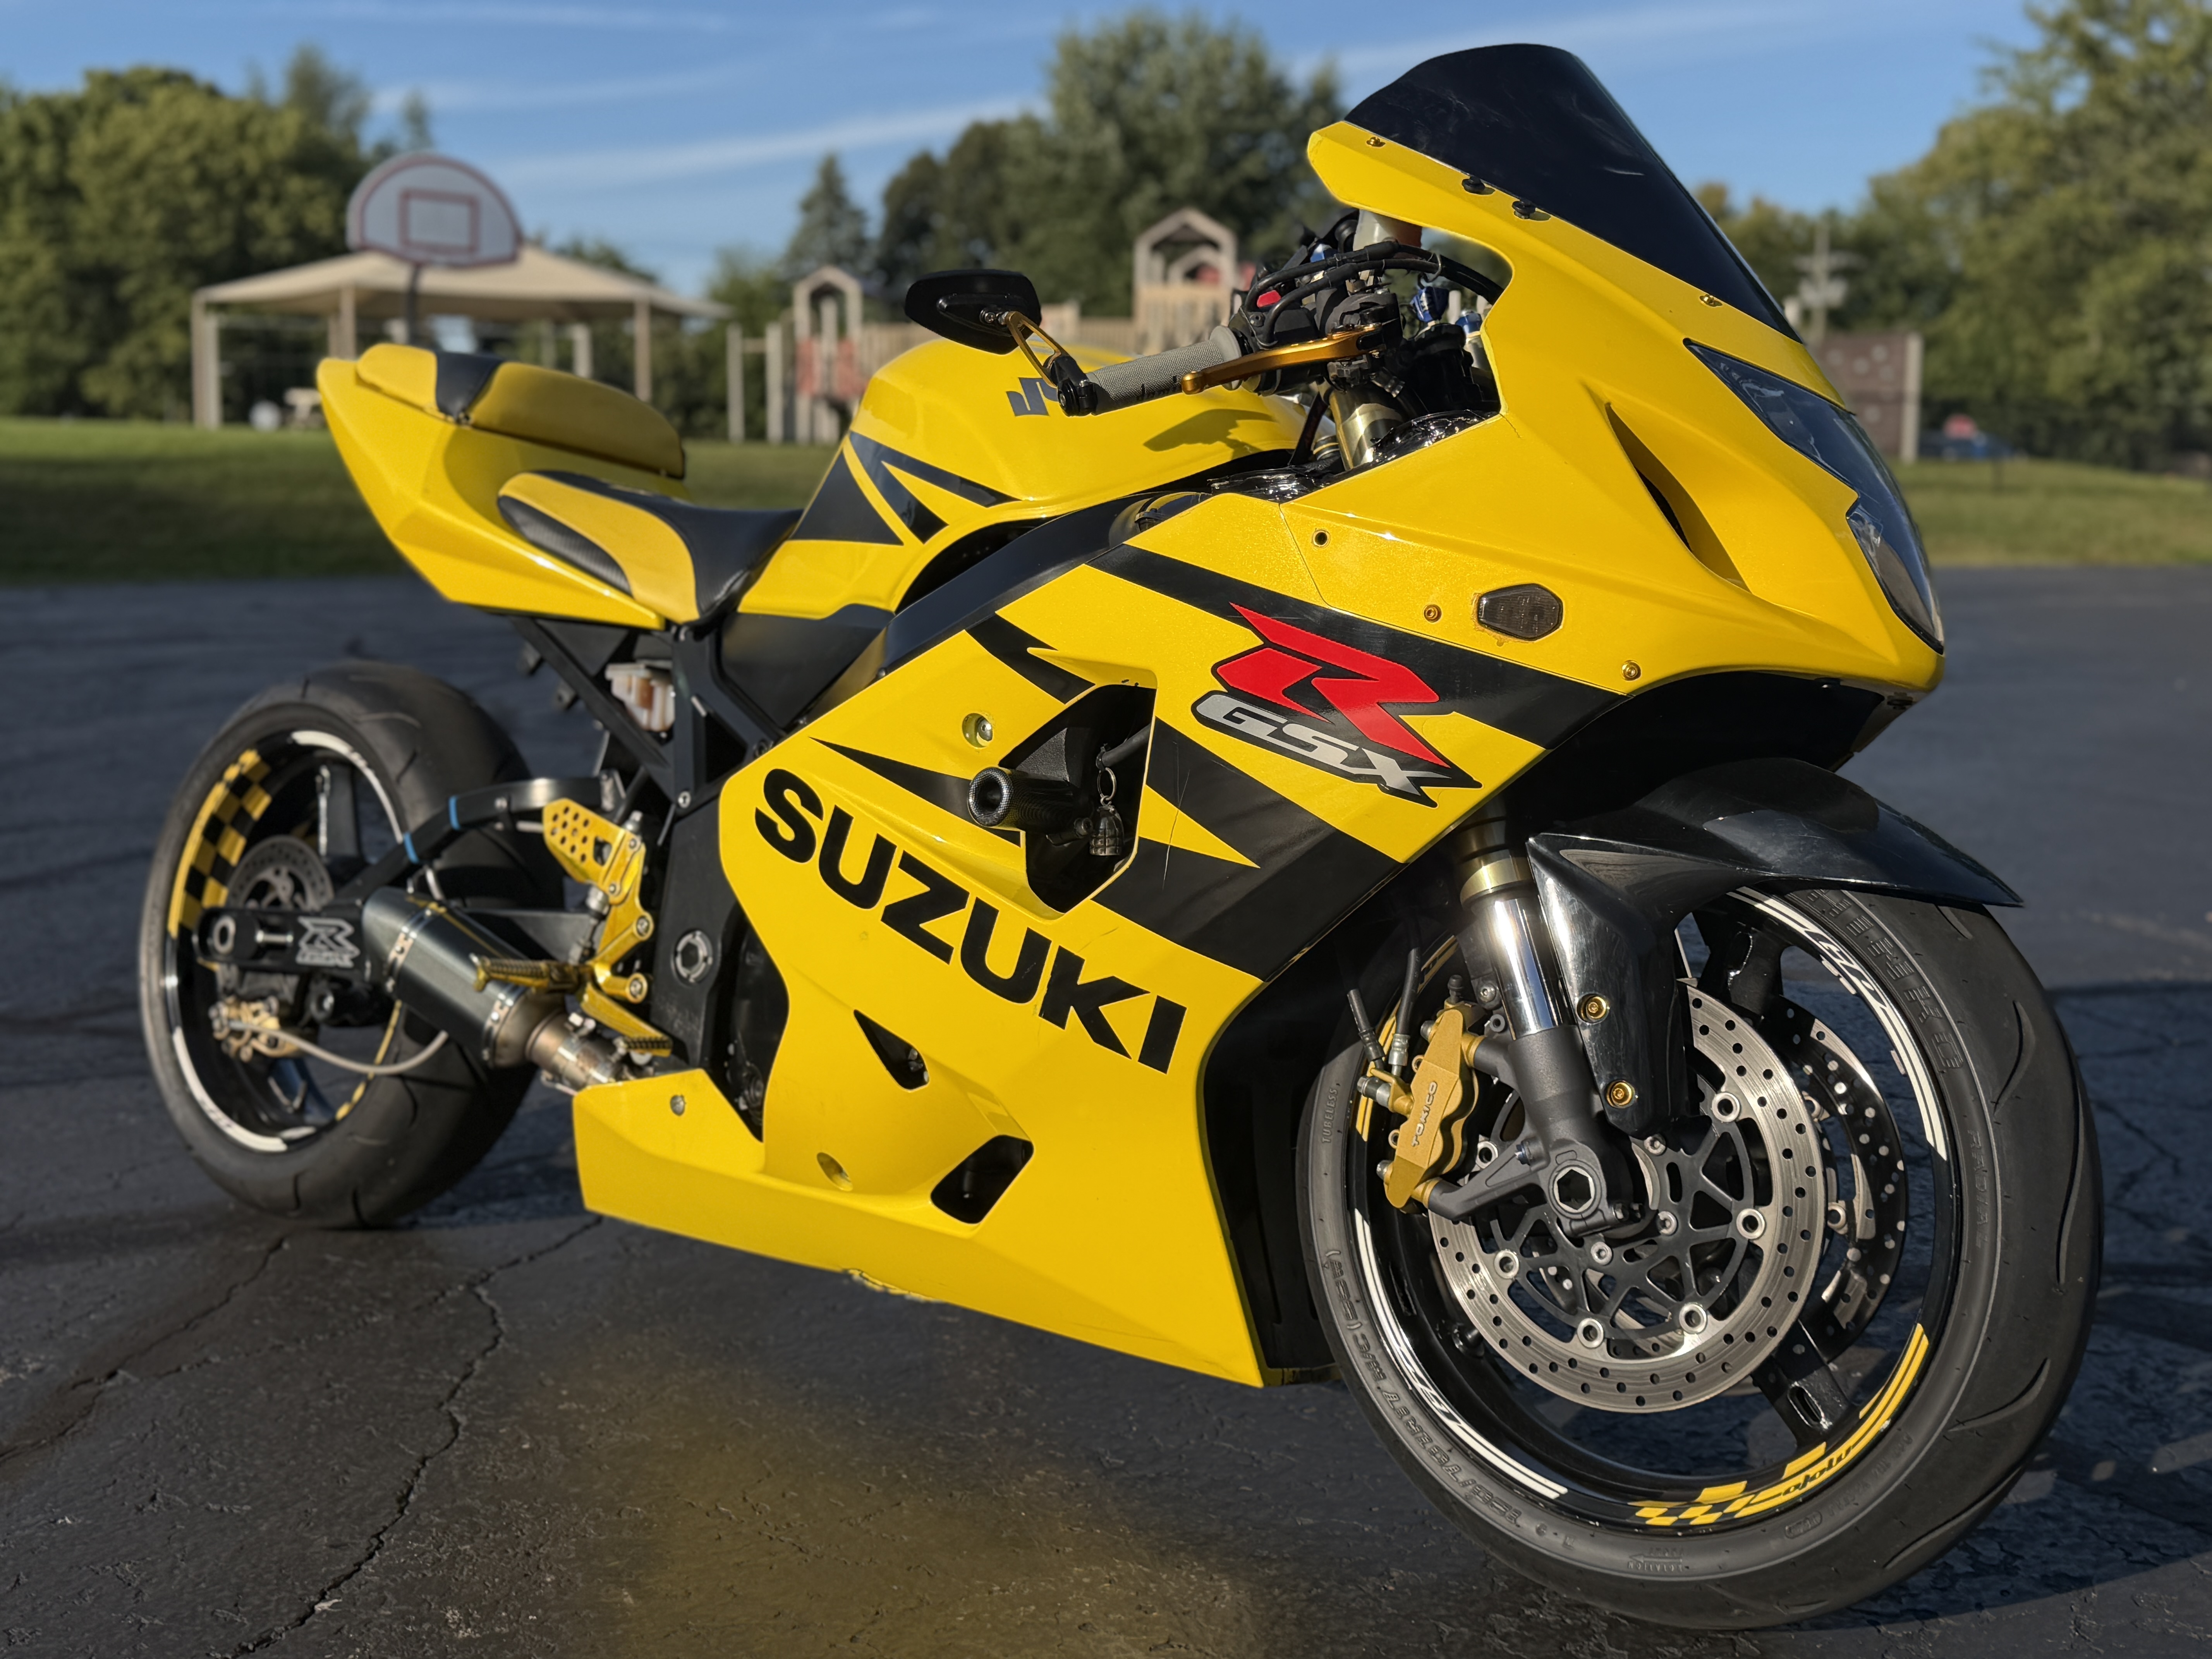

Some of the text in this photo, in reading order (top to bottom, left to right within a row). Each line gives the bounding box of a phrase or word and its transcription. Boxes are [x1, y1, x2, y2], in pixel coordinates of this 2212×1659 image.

[1196, 694, 1452, 796] GSX
[755, 768, 1187, 1075] SUZUKI
[1804, 890, 1965, 1073] HINKO
[1321, 1087, 1339, 1143] TUBELESS
[1411, 1080, 1437, 1147] TOKICO
[1967, 1129, 1989, 1249] RADIAL
[1782, 1445, 1851, 1496] moto
